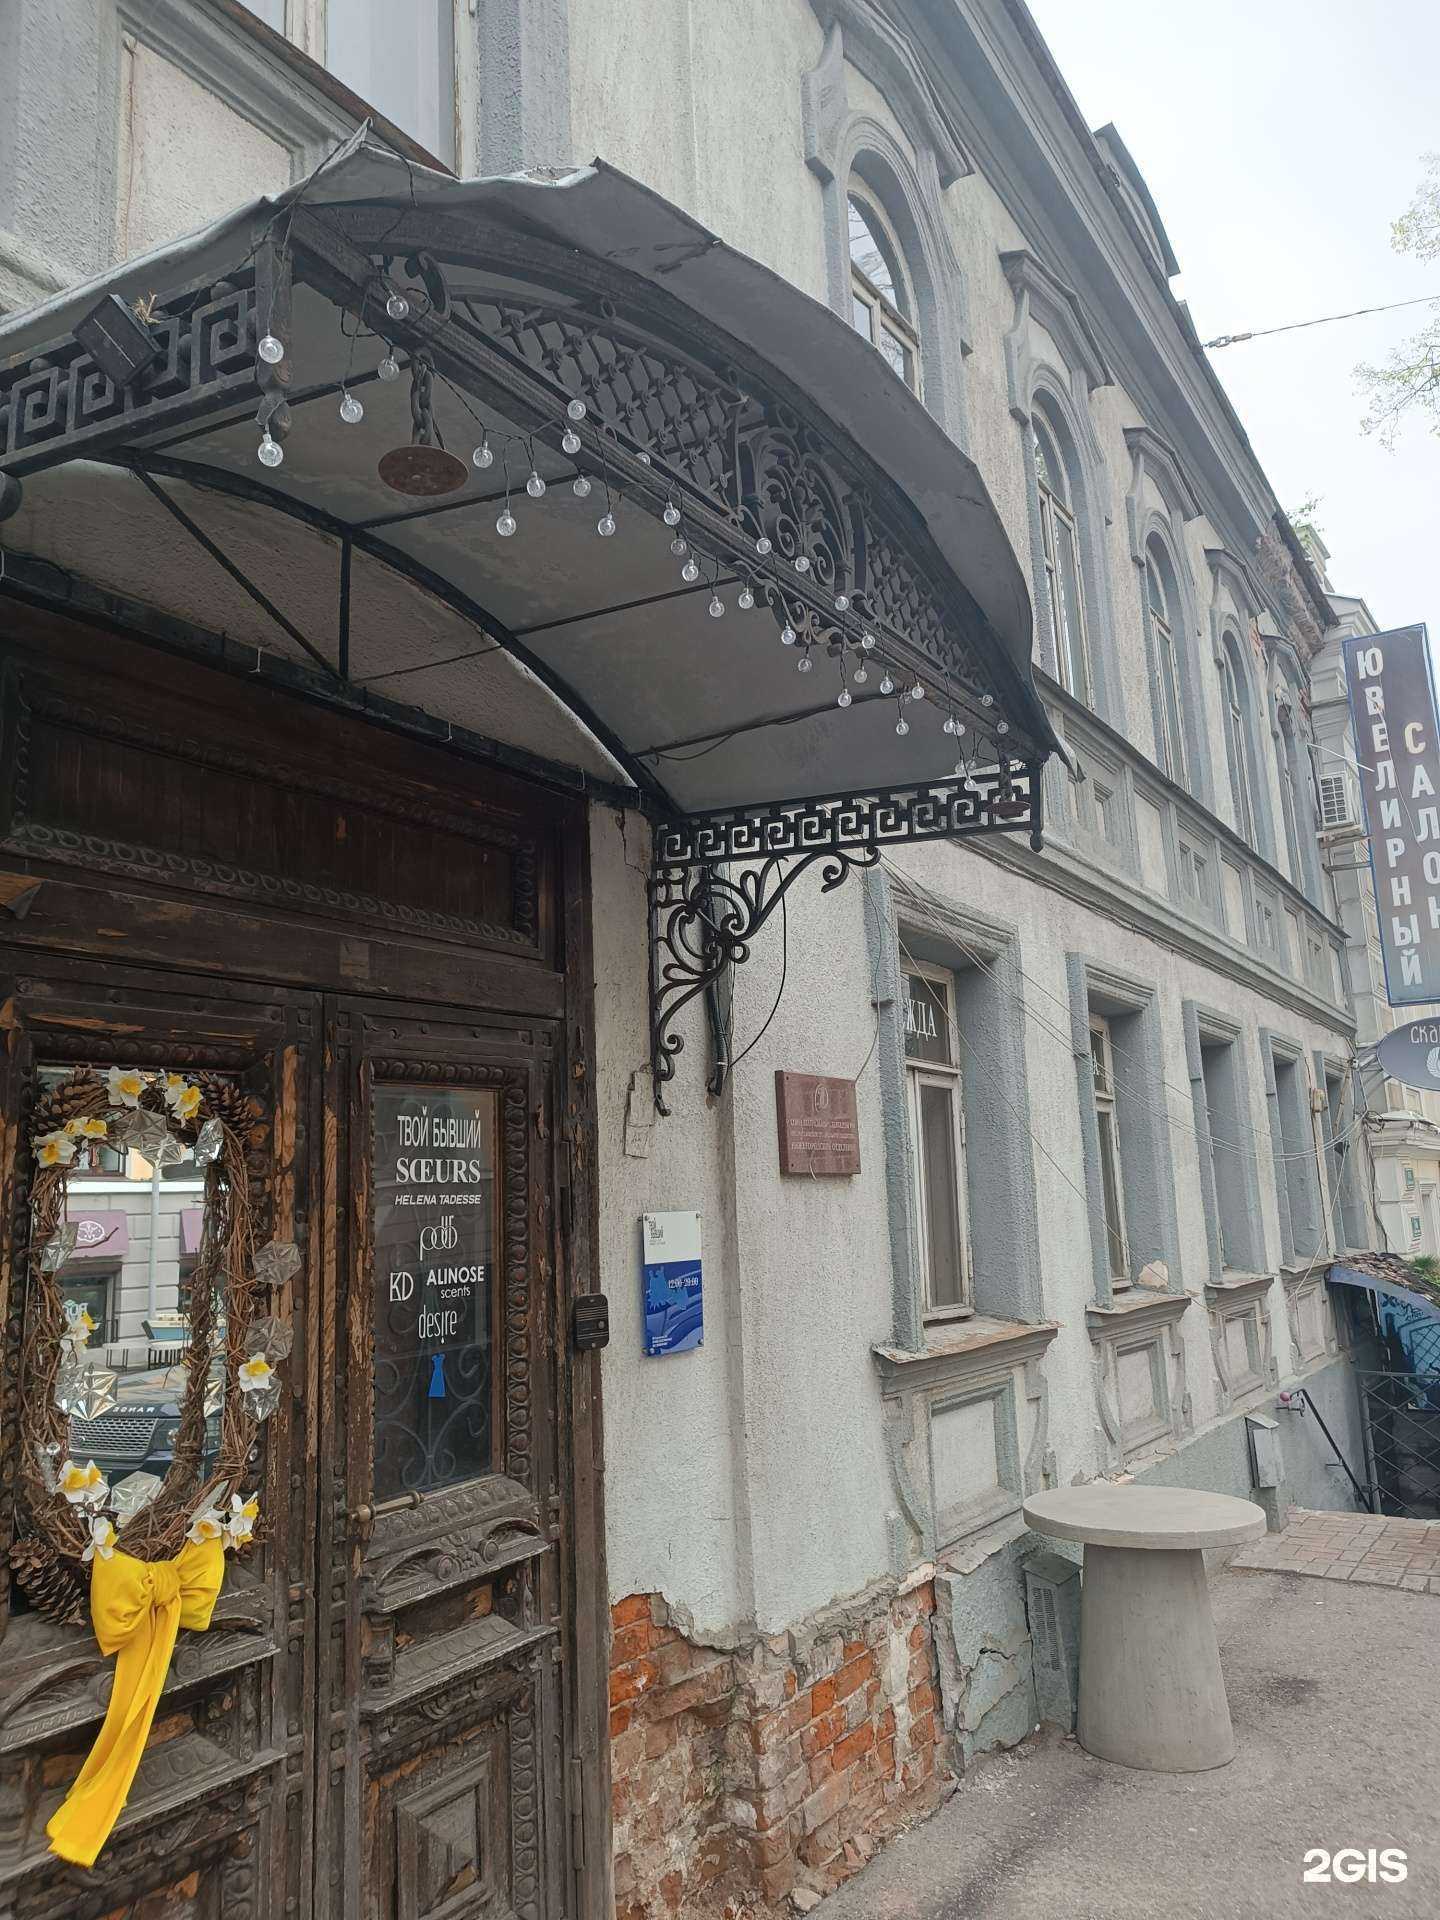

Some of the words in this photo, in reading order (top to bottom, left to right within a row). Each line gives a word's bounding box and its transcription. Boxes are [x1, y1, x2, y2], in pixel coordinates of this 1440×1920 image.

[1356, 647, 1422, 987] ЮВЕЛИРНЫЙ
[902, 998, 937, 1041] ЖДА
[397, 1106, 429, 1147] ТВОЙ
[433, 1109, 481, 1149] БЫВШИЙ
[396, 1157, 481, 1184] SŒURS
[395, 1194, 437, 1206] HELENA
[439, 1194, 482, 1205] TADESSE
[426, 1266, 485, 1286] ALINOSE
[440, 1286, 471, 1299] scents
[418, 1304, 457, 1344] desire
